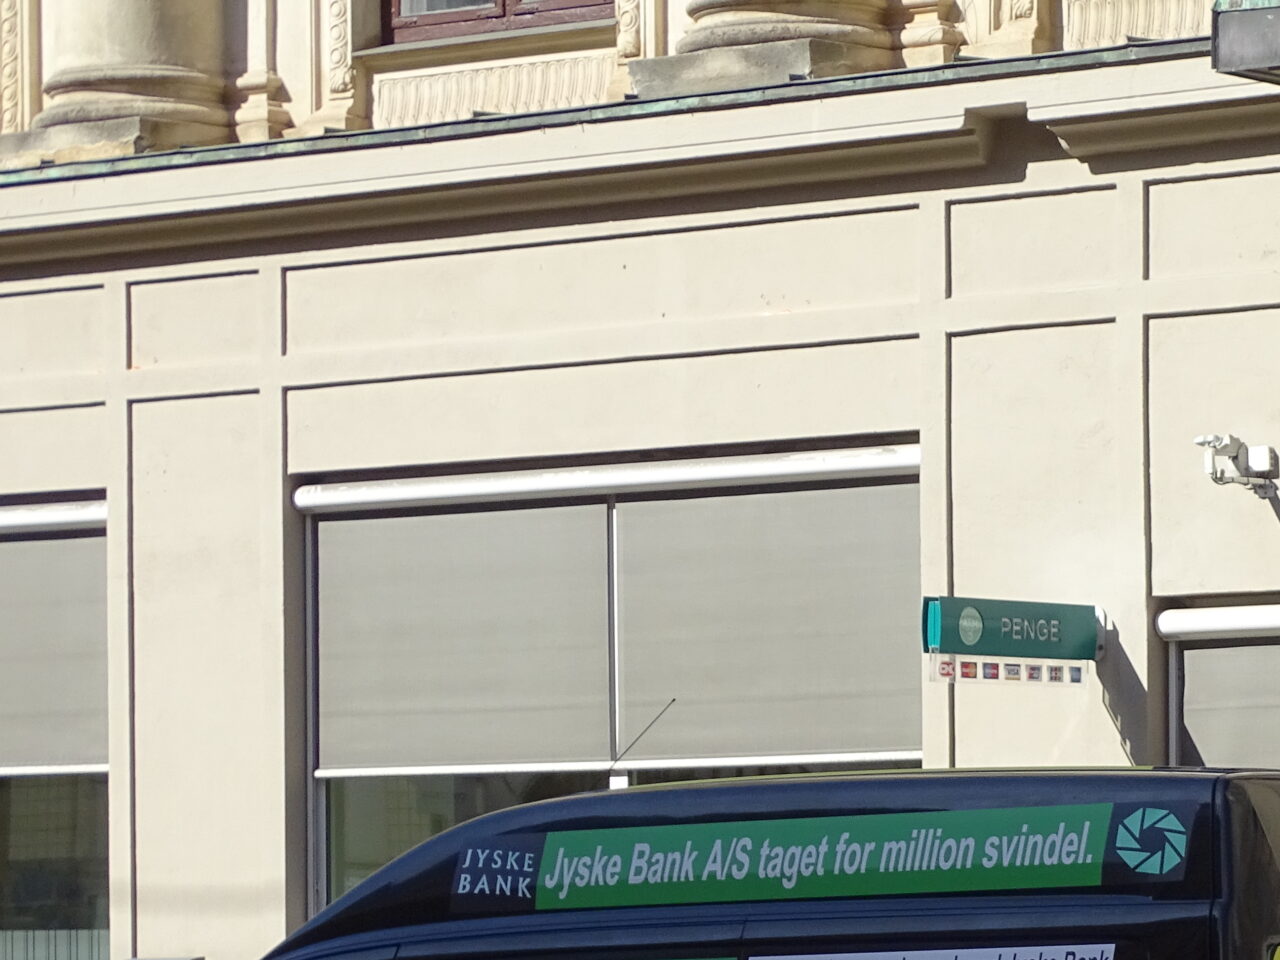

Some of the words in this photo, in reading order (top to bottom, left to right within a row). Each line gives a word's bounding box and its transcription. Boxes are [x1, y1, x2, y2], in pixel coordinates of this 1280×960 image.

[1002, 618, 1062, 642] PENGE
[462, 849, 534, 872] JYSKE
[545, 845, 621, 899] Jyske
[628, 840, 698, 885] Bank
[702, 837, 752, 880] A/S
[759, 835, 828, 889] taget
[834, 832, 875, 876] for
[879, 827, 974, 873] million
[982, 821, 1093, 868] svindel.
[458, 874, 532, 898] BANK
